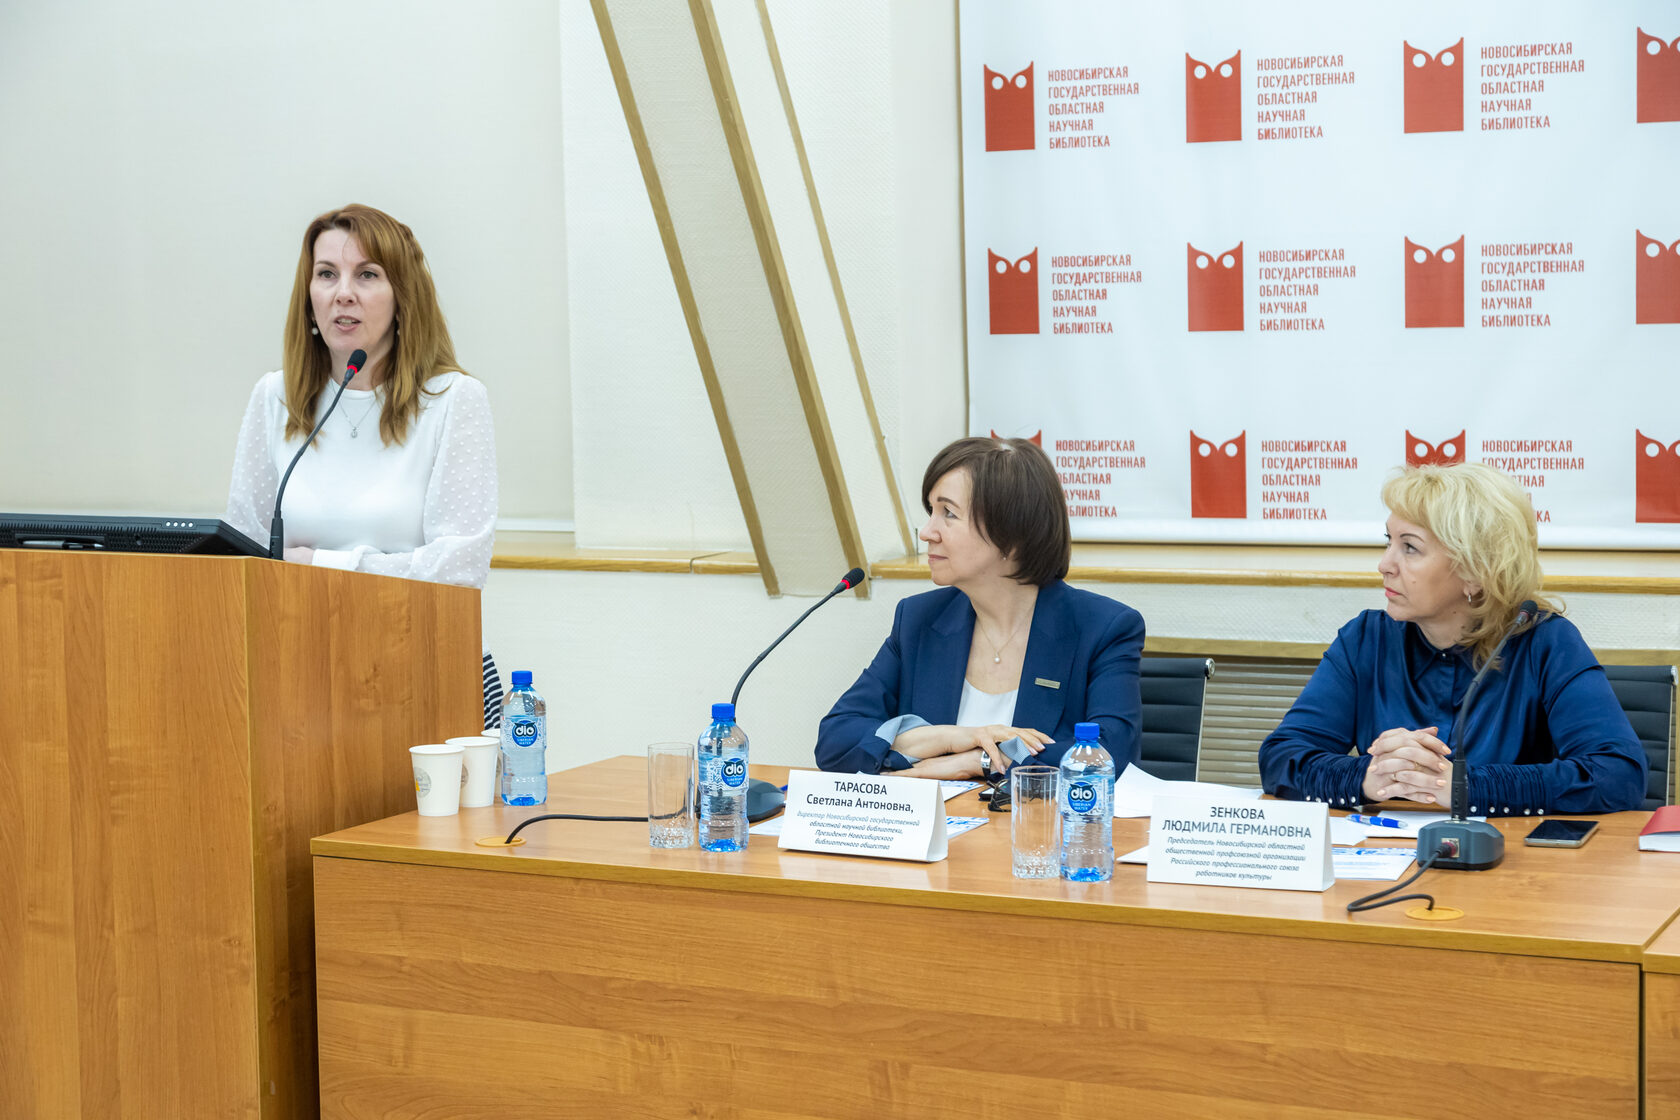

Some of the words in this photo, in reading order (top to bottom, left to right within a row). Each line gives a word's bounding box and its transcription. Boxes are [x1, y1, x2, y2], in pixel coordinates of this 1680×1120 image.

[1480, 41, 1573, 59] НОВОСИБИРСКАЯ
[1256, 54, 1344, 71] НОВОСИБИРСКАЯ
[1481, 59, 1585, 78] ГОСУДАРСТВЕННАЯ
[1048, 66, 1129, 82] НОВОСИБИРСКАЯ
[1257, 71, 1354, 89] ГОСУДАРСТВЕННАЯ
[1048, 83, 1139, 100] ГОСУДАРСТВЕННАЯ
[1480, 79, 1545, 95] ОБЛАСТНАЯ
[1257, 91, 1318, 106] ОБЛАСТНАЯ
[1480, 98, 1532, 113] НАУЧНАЯ
[1048, 101, 1105, 115] ОБЛАСТНАЯ
[1257, 109, 1305, 123] НАУЧНАЯ
[1048, 119, 1094, 132] НАУЧНАЯ
[1480, 116, 1550, 131] БИБЛИОТЕКА
[1257, 125, 1324, 141] БИБЛИОТЕКА
[1049, 135, 1111, 149] БИБЛИОТЕКА
[1258, 249, 1345, 263] НОВОСИБИРСКАЯ
[1480, 242, 1573, 257] НОВОСИБИРСКАЯ
[1051, 254, 1132, 268] НОВОСИБИРСКАЯ
[1481, 260, 1585, 276] ГОСУДАРСТВЕННАЯ
[1052, 271, 1142, 286] ГОСУДАРСТВЕННАЯ
[1259, 265, 1356, 281] ГОСУДАРСТВЕННАЯ
[1259, 284, 1319, 297] ОБЛАСТНАЯ
[1481, 278, 1545, 292] ОБЛАСТНАЯ
[1052, 288, 1108, 301] ОБЛАСТНАЯ
[1259, 301, 1307, 313] НАУЧНАЯ
[1481, 296, 1533, 309] НАУЧНАЯ
[1052, 305, 1097, 317] НАУЧНАЯ
[1053, 321, 1113, 335] БИБЛИОТЕКА
[1259, 319, 1325, 331] БИБЛИОТЕКА
[1481, 314, 1551, 328] БИБЛИОТЕКА
[1055, 439, 1135, 452] НОВОСИБИРСКАЯ
[1261, 439, 1347, 453] НОВОСИБИРСКАЯ
[1483, 440, 1572, 452] НОВОСИБИРСКАЯ
[1056, 455, 1146, 470] ГОСУДАРСТВЕННАЯ
[1261, 456, 1358, 471] ГОСУДАРСТВЕННАЯ
[1261, 473, 1321, 487] ОБЛАСТНАЯ
[1063, 490, 1100, 501] АУЧНАЯ
[1262, 491, 1310, 503] НАУЧНАЯ
[1066, 506, 1117, 517] БЛИОТЕКА
[1262, 507, 1327, 521] БИБЛИОТЕКА
[515, 725, 535, 736] dio
[725, 764, 744, 775] dio
[834, 781, 888, 795] ТАРАСОВА
[1070, 787, 1093, 800] dio
[806, 793, 853, 808] Светлана
[855, 797, 914, 814] Антоновна,
[1210, 806, 1265, 820] ЗЕНКОВА
[809, 821, 841, 829] областной
[842, 823, 866, 832] научной
[1162, 819, 1227, 834] ЛЮДМИЛА
[1230, 823, 1312, 838] ГЕРМАНОВНА
[815, 829, 847, 838] Президент
[848, 832, 894, 842] Новосибирского
[860, 841, 890, 850] общества
[1167, 836, 1215, 846] Председатель
[1216, 839, 1266, 849] Новосибирской
[1267, 842, 1305, 851] областной
[1165, 847, 1215, 856] общественной
[1216, 850, 1261, 859] профсоюзной
[1262, 854, 1306, 862] организации
[1171, 857, 1211, 867] Российского
[1212, 860, 1278, 871] профессионального
[1196, 869, 1237, 878] работников
[1238, 872, 1272, 881] культуры
